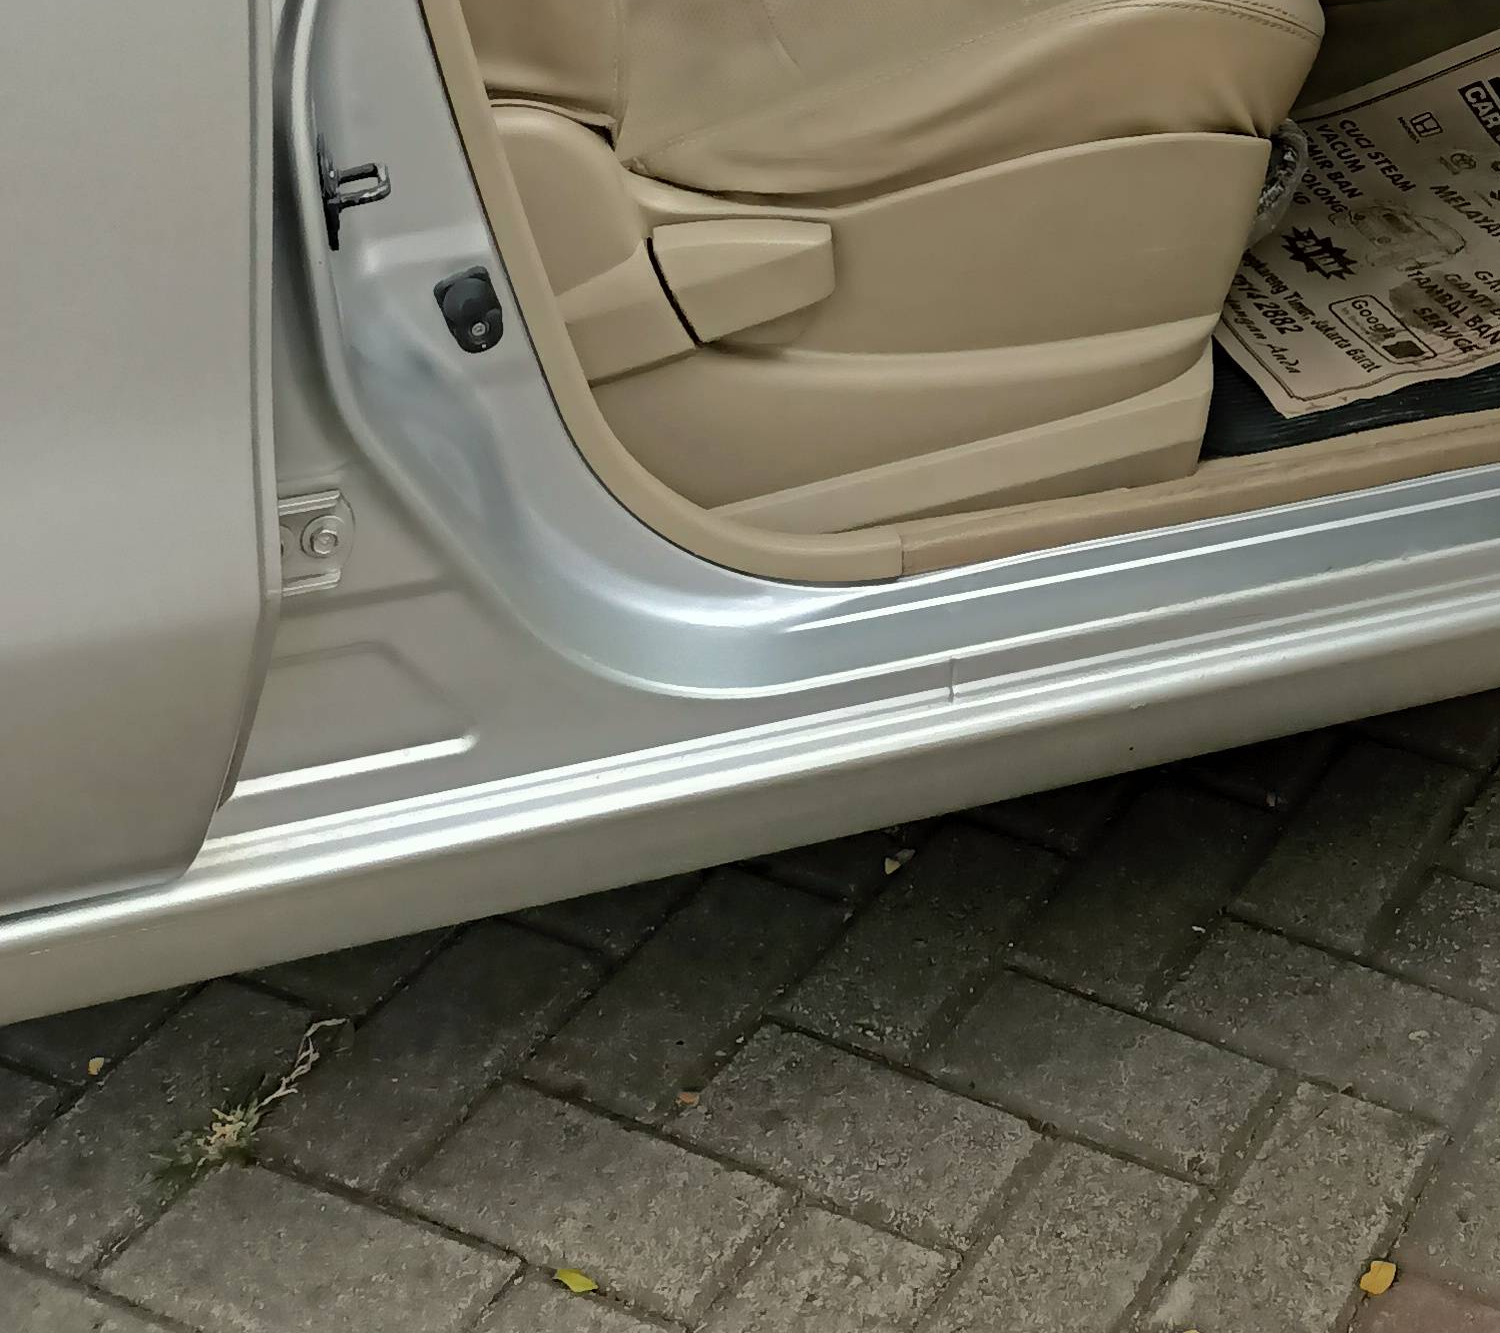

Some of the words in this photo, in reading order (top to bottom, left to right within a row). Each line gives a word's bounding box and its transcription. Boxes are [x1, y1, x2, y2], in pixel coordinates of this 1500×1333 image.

[1316, 123, 1366, 173] VACUM
[1339, 119, 1375, 149] CUCI
[1367, 151, 1416, 192] STEAM
[1326, 171, 1364, 200] BAN
[1254, 302, 1304, 336] 2882
